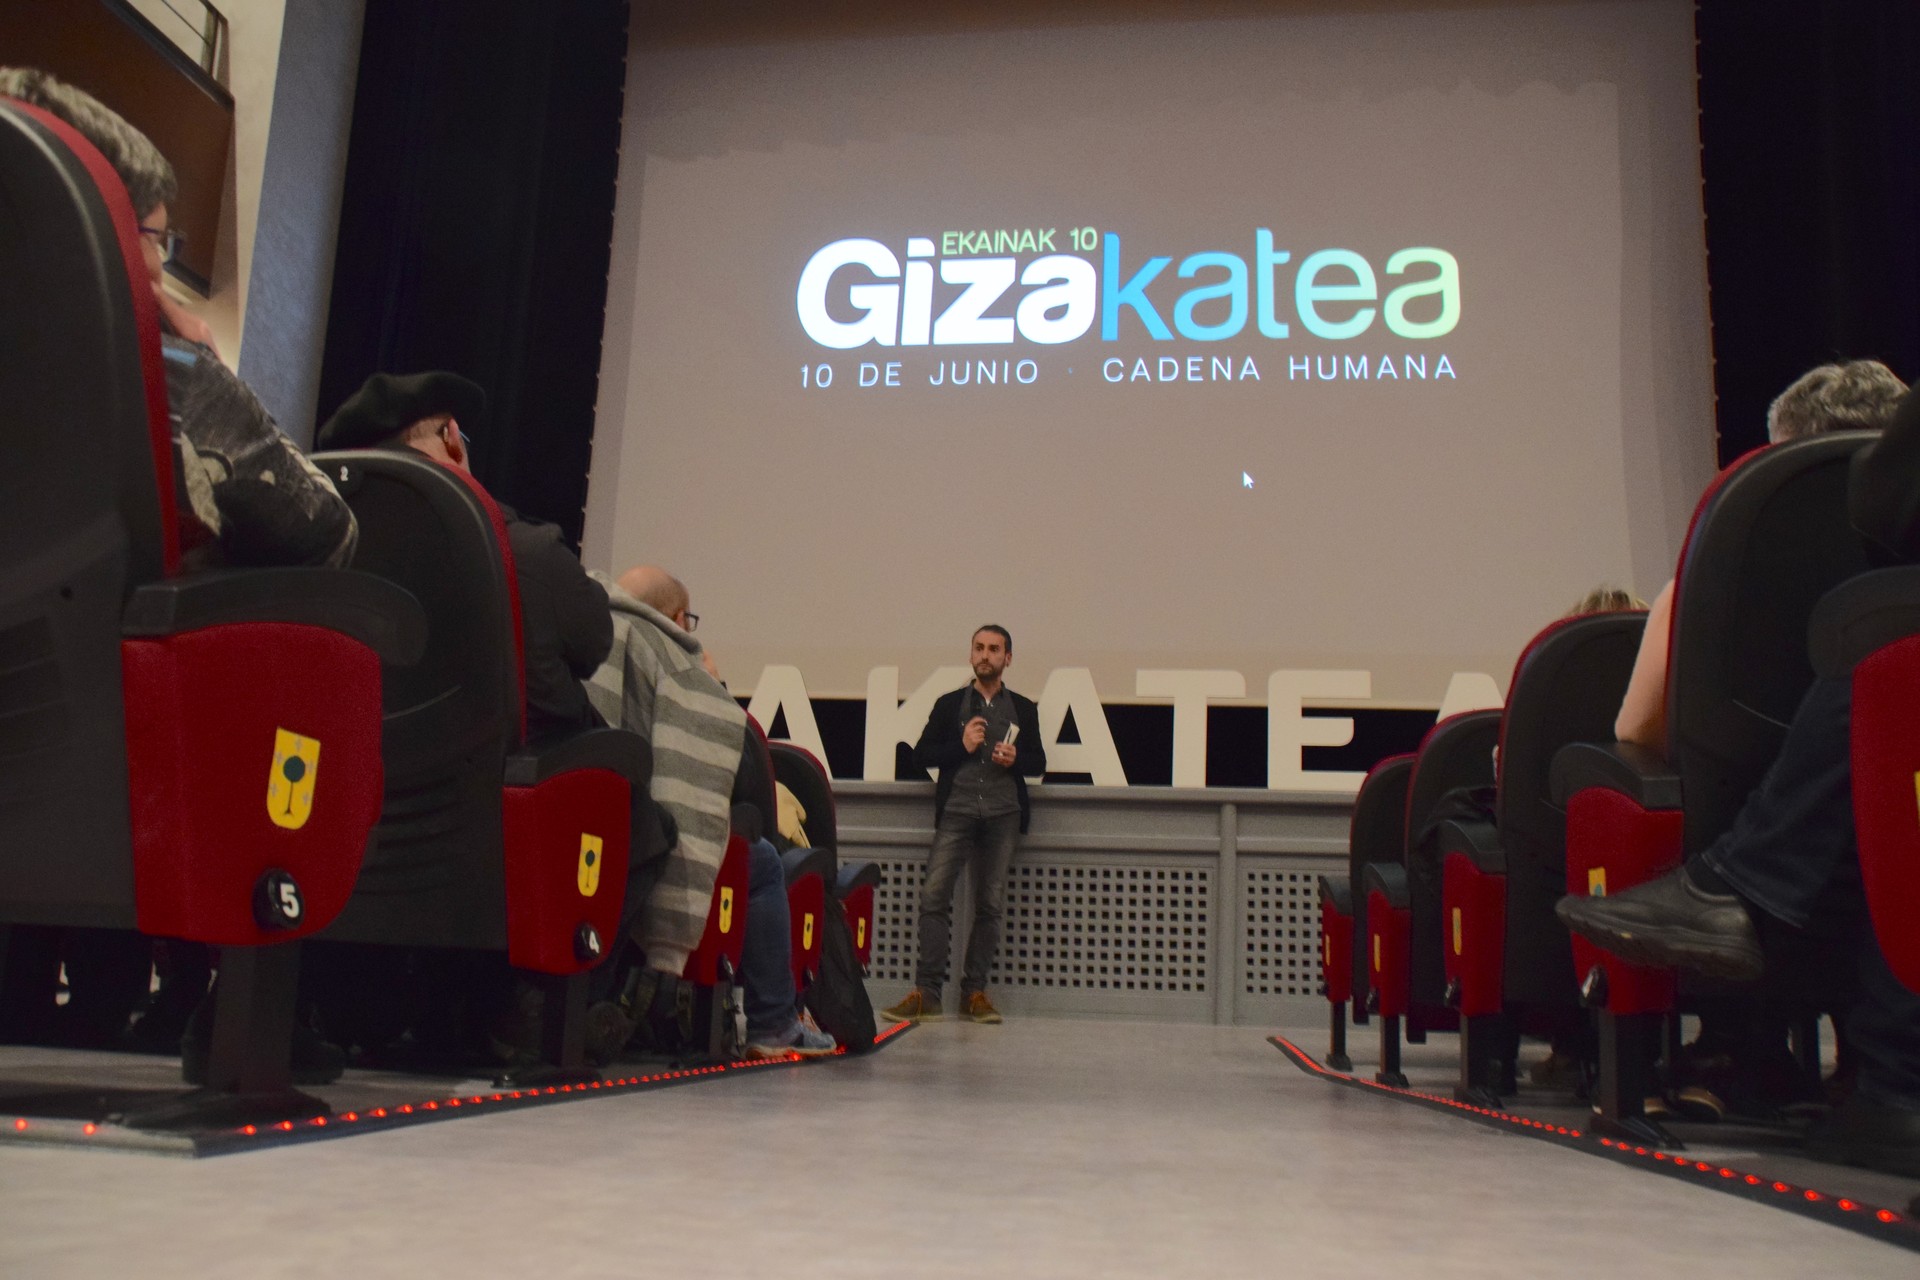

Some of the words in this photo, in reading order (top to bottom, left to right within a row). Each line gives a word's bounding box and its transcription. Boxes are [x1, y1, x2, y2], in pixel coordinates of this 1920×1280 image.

[941, 228, 1057, 255] EKAINAK
[1069, 226, 1098, 251] 10
[800, 362, 832, 388] 10
[859, 361, 902, 387] DE
[929, 358, 1039, 386] JUNIO
[1102, 356, 1261, 383] CADENA
[1288, 354, 1457, 381] HUMANA
[280, 882, 300, 918] 5
[589, 930, 600, 954] 4
